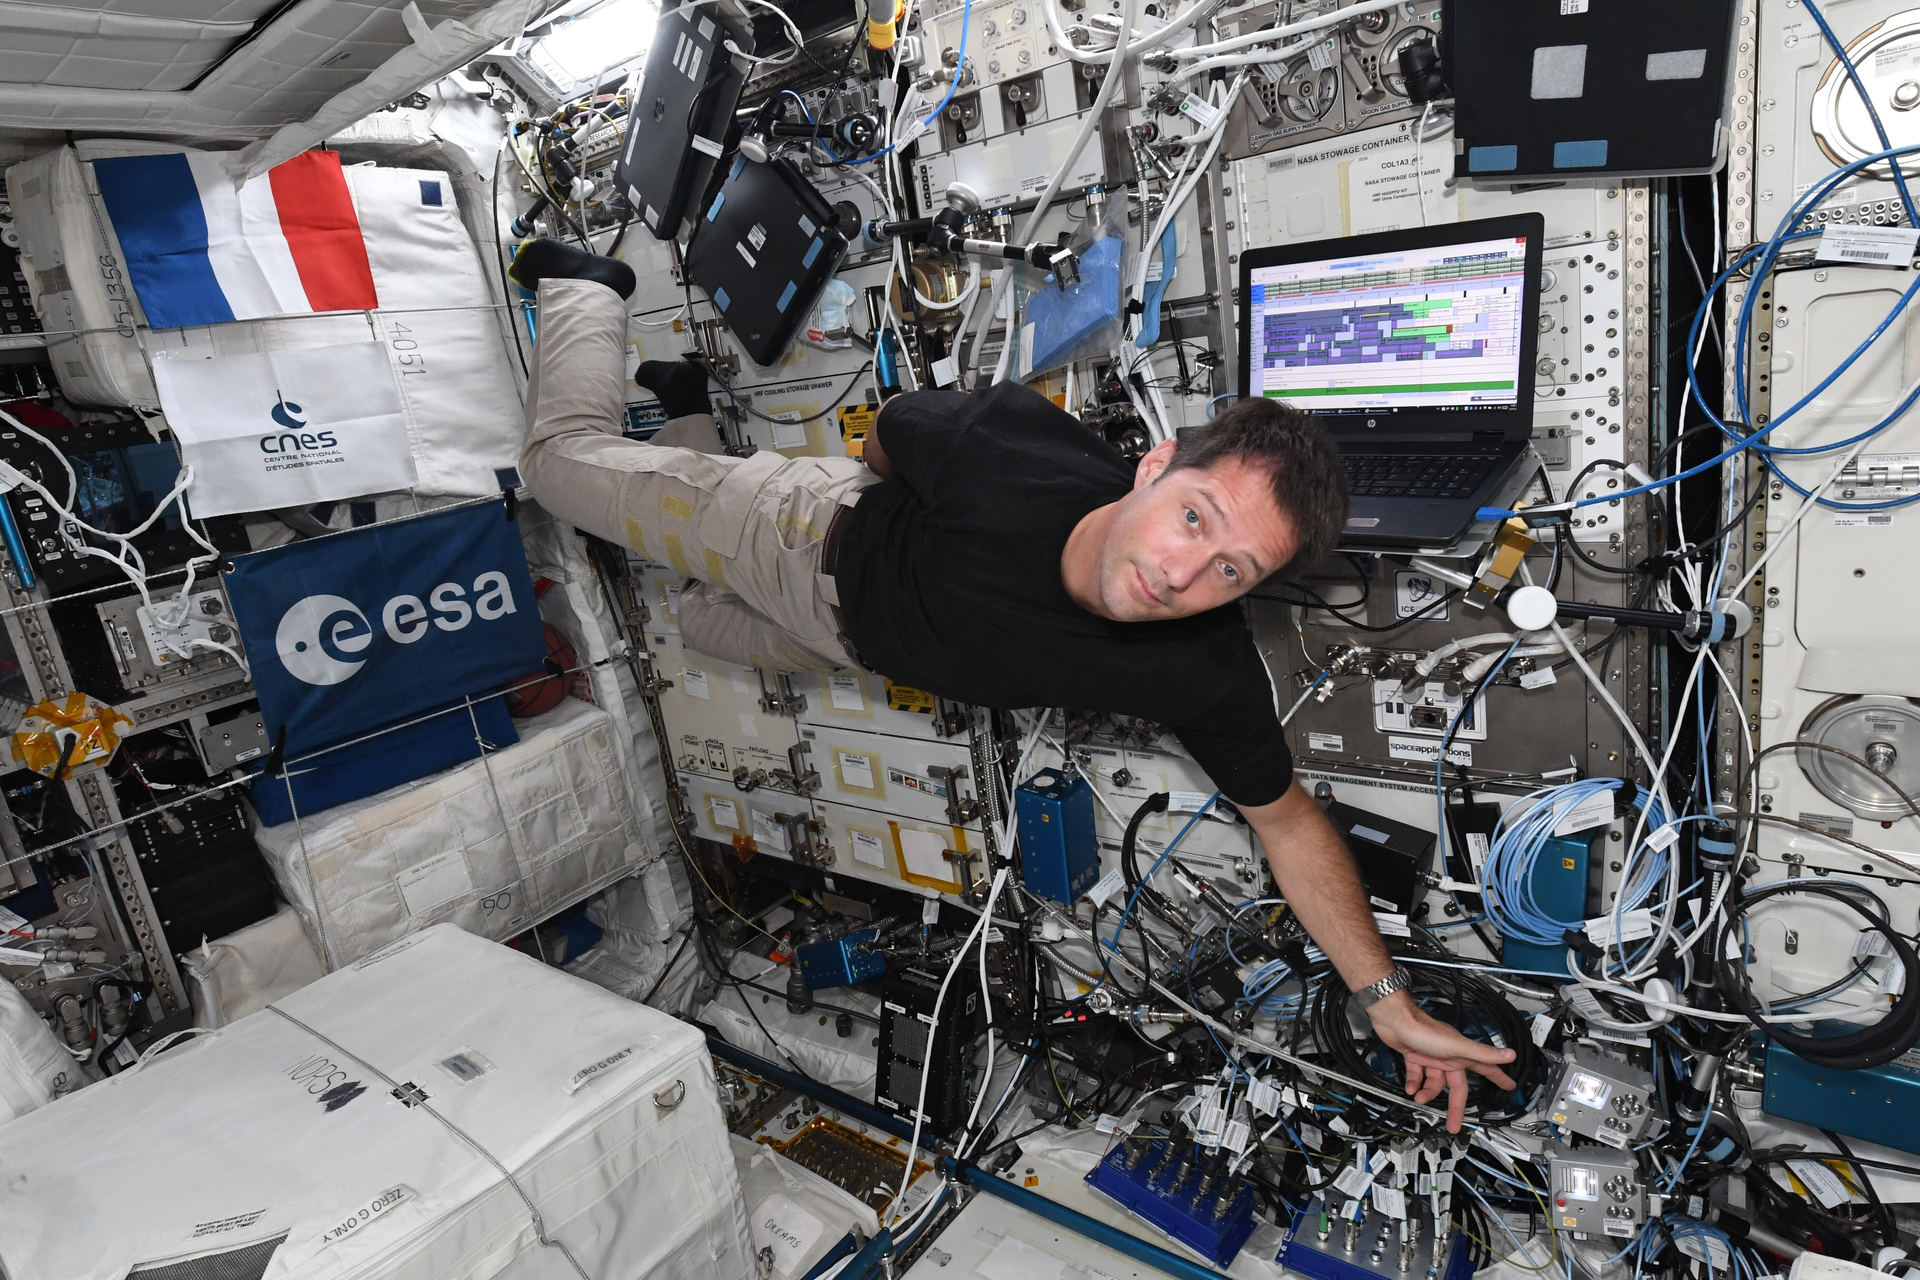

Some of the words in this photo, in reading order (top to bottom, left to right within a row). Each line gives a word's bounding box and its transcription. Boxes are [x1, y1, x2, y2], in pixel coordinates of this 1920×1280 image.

[1783, 23, 1802, 31] UNLOCK
[1360, 108, 1379, 116] ARGON
[1391, 100, 1412, 110] SUPPLY
[589, 128, 613, 143] RESEARCH
[1251, 132, 1272, 142] CLEANING
[1273, 130, 1283, 138] GAS
[1283, 126, 1299, 136] SUPPLY
[1300, 122, 1319, 131] INSERT
[1297, 155, 1319, 166] NASA
[1320, 145, 1360, 161] STOWAGE
[1361, 134, 1410, 151] CONTAINER
[1380, 174, 1407, 183] STOWAGE
[1408, 168, 1441, 179] CONTAINER
[389, 321, 426, 377] 4051
[764, 388, 786, 396] COOLING
[786, 384, 811, 394] STOWAGE
[811, 381, 833, 390] DRAWER
[260, 430, 338, 454] cnes
[264, 454, 298, 463] CENTRE
[301, 450, 342, 459] NATIONAL
[265, 462, 305, 471] D'ÉTUDES
[306, 457, 345, 466] SPATIALES
[382, 570, 517, 644] esa
[748, 746, 769, 754] PAYLOAD
[1390, 742, 1471, 758] spaceapplictions
[1310, 773, 1329, 782] DATA
[1329, 775, 1378, 788] MANAGEMENT
[1379, 781, 1408, 791] SYSTEM
[1409, 785, 1438, 795] ACCESS
[1441, 790, 1463, 798] PNEL
[1189, 859, 1208, 868] ACCESS
[1289, 921, 1297, 932] MAX
[571, 1065, 598, 1084] ZERO
[599, 1061, 607, 1069] G
[606, 1047, 632, 1065] ONLY
[913, 1184, 928, 1195] RPDA
[371, 1188, 404, 1213] ZERO
[244, 1214, 260, 1222] LEFT
[357, 1208, 370, 1220] G
[192, 1230, 214, 1238] CLEAR
[237, 1220, 256, 1228] TIMES
[323, 1217, 357, 1243] ONLY
[764, 1218, 802, 1249] DREAMS
